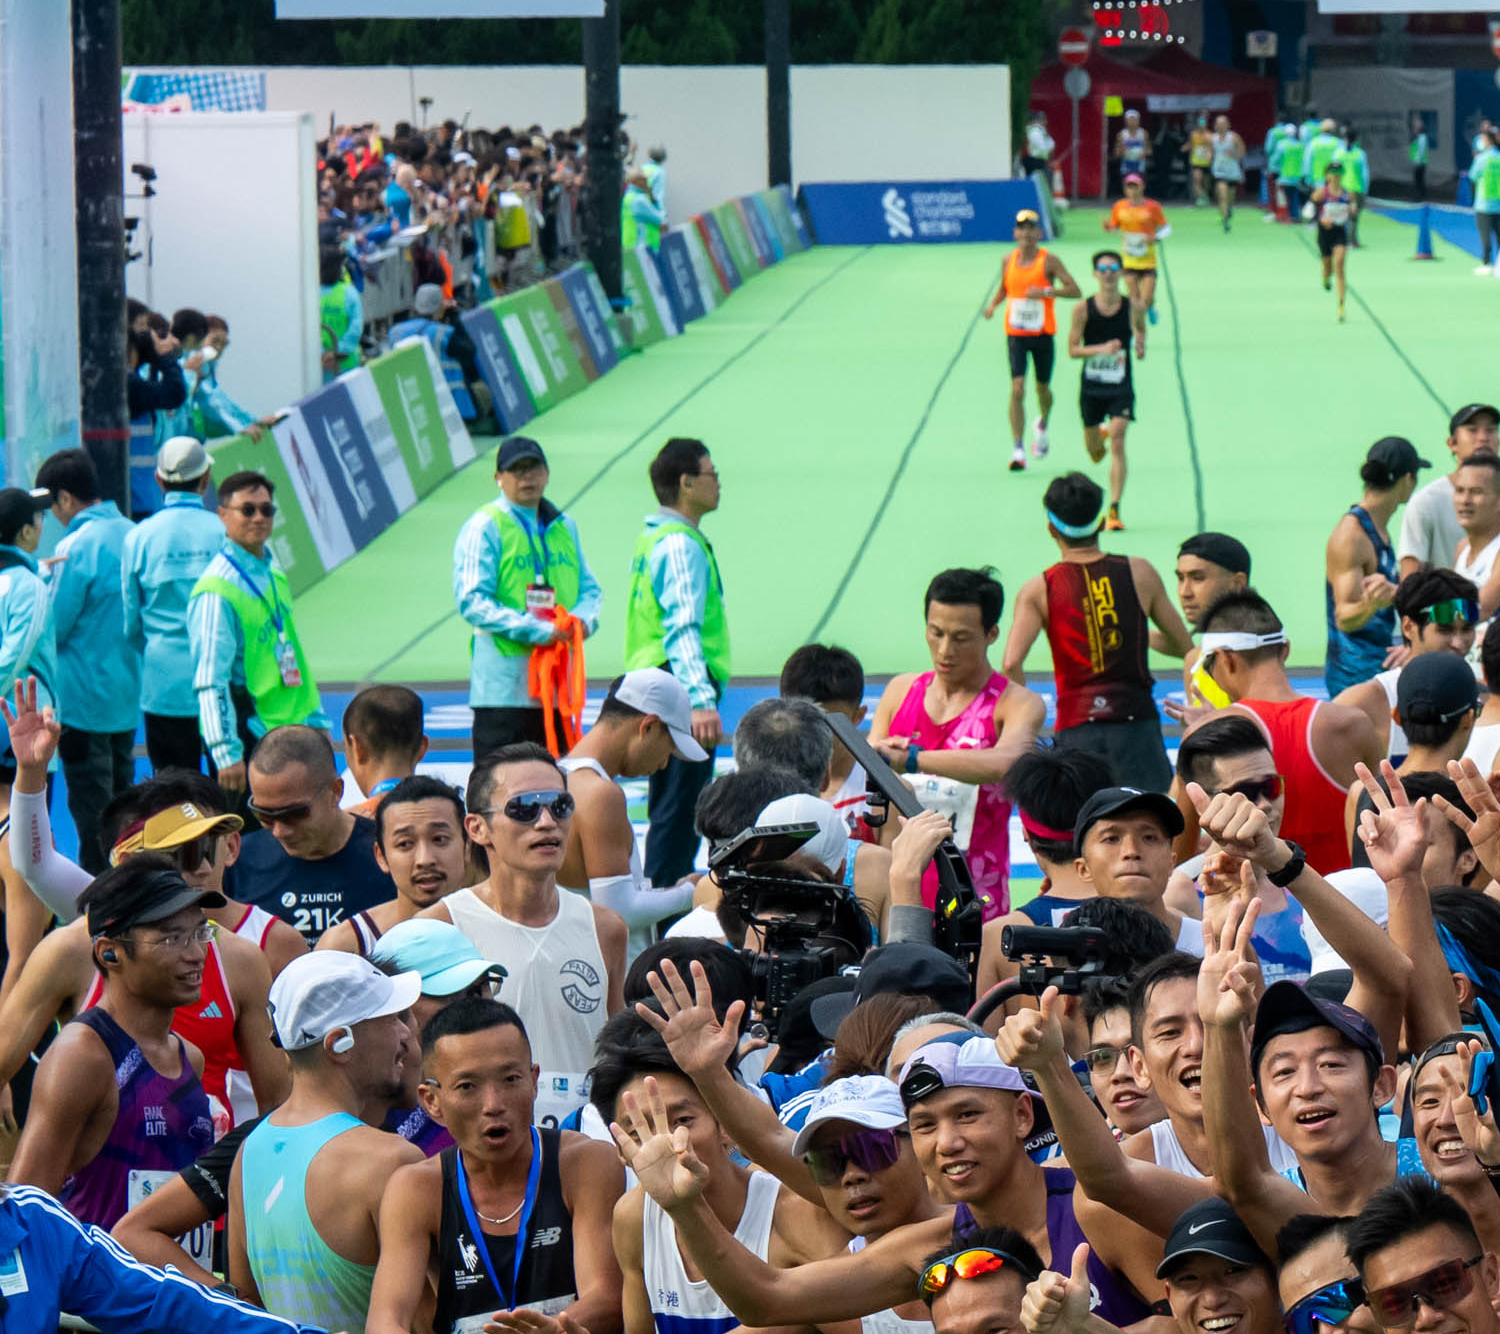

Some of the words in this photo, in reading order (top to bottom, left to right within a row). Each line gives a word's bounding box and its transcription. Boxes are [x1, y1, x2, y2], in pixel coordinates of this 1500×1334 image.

[1090, 577, 1120, 631] SRC
[301, 893, 342, 903] ZURICH
[292, 907, 345, 931] 21K
[143, 1106, 165, 1119] FMAC
[145, 1122, 168, 1137] ELITE
